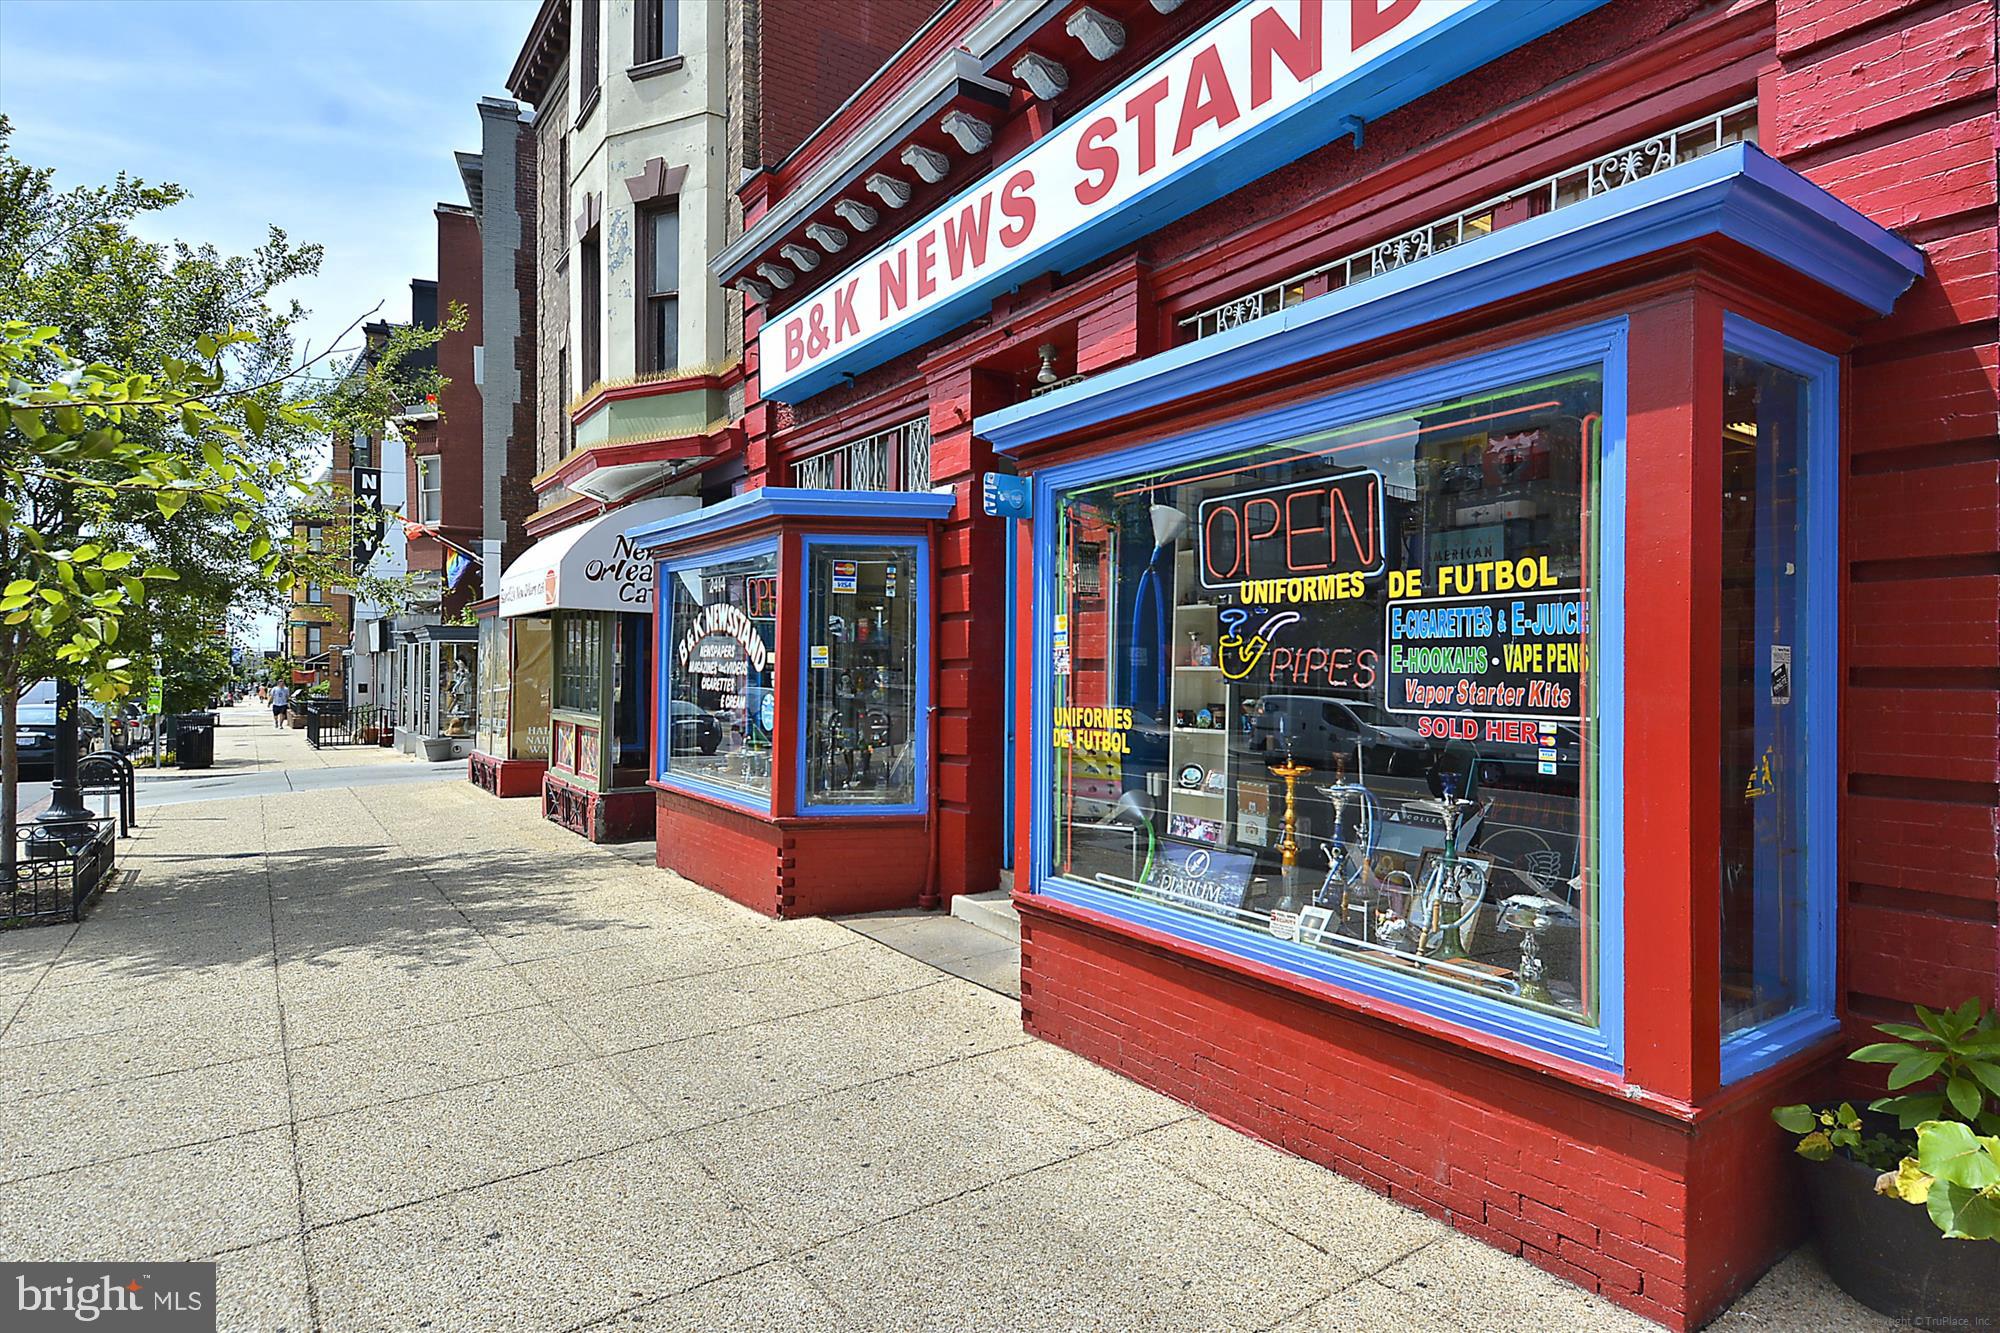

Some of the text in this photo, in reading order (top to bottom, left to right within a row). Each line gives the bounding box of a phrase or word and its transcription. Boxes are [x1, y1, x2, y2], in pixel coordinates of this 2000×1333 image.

[784, 278, 861, 372] B&K
[879, 170, 1037, 320] NEWS
[1205, 481, 1376, 578] OPEN
[1240, 555, 1558, 605] UNIFORMES DE FUTBOL
[1391, 605, 1493, 640] E-CIGARETTES
[1497, 609, 1507, 634] &
[699, 644, 736, 658] NEWSPAPERS
[1391, 643, 1590, 674] E-HOOKAHS VAPE PENS
[688, 660, 718, 675] MAGAZINES
[1269, 648, 1379, 689] PIPES
[701, 677, 735, 693] CIGARETTES
[1405, 679, 1571, 709] Vapor Starter Kits
[1053, 706, 1133, 730] UNIFORMES
[1418, 716, 1479, 741] SOLD
[1053, 727, 1131, 754] DE FUTBOL
